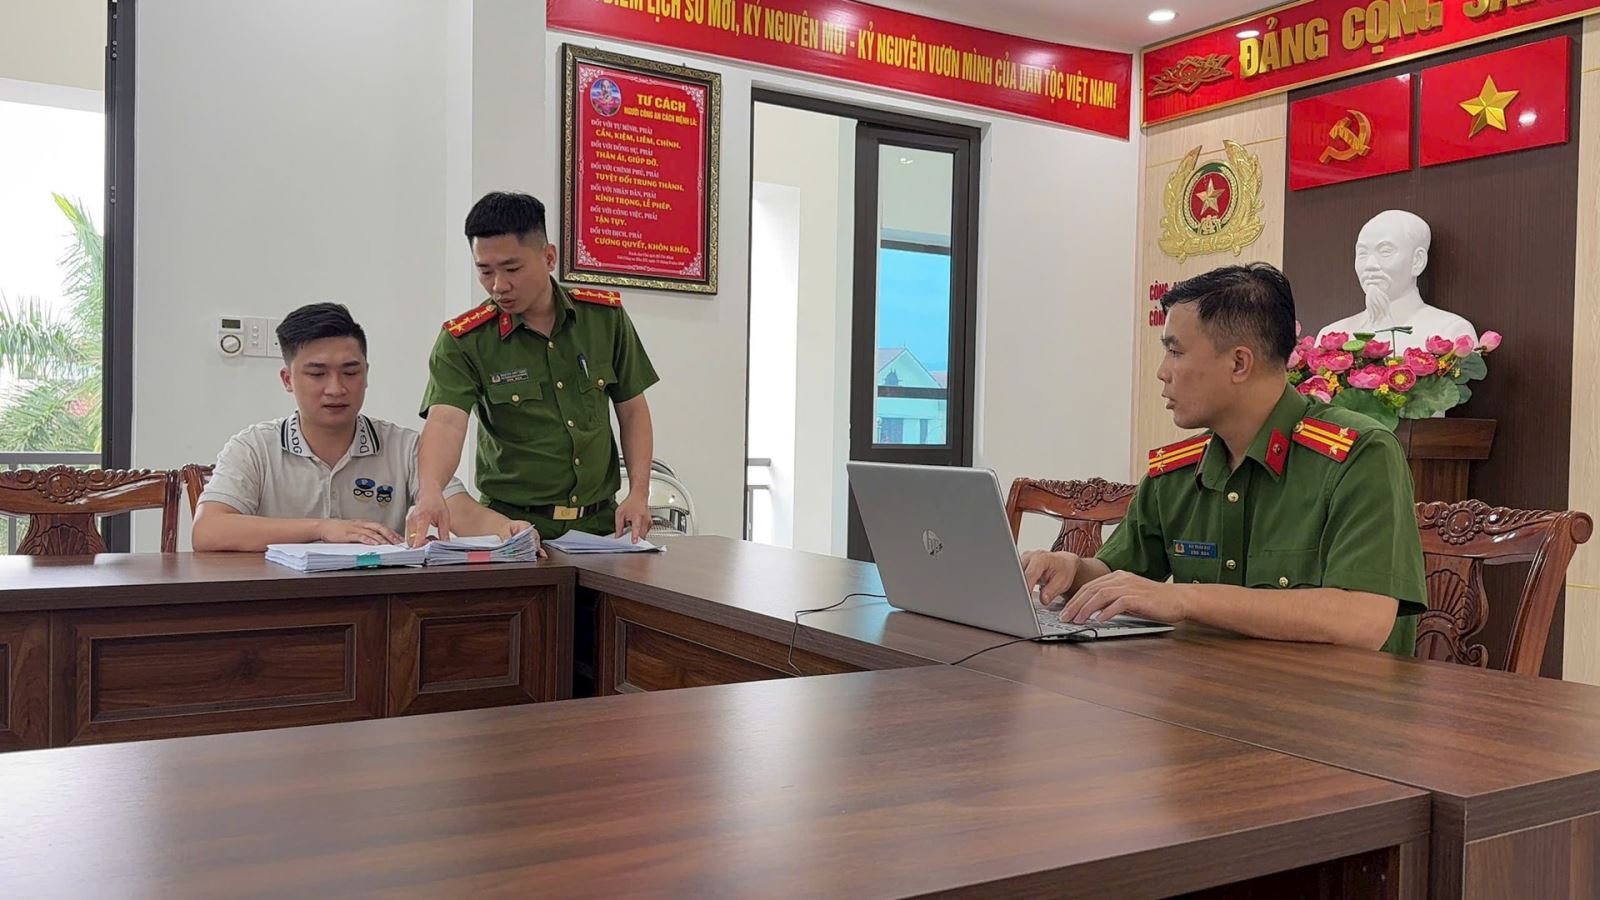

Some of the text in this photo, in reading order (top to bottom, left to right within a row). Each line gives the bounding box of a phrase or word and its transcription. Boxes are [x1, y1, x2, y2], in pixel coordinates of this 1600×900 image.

[1239, 16, 1329, 80] ĐẢNG
[764, 9, 819, 49] NGUYÊN
[858, 20, 874, 61] KỶ
[876, 33, 926, 72] NGUYÊN
[928, 44, 960, 79] VƯƠN
[962, 47, 993, 85] MÌNH
[994, 51, 1017, 90] CỦA
[1044, 64, 1064, 104] TỘC
[1066, 69, 1089, 109] VIỆT
[1089, 78, 1118, 110] NAM!
[636, 94, 687, 113] TƯ CÁCH
[595, 173, 618, 183] TUYỆT
[618, 175, 632, 184] ĐỐI
[633, 178, 657, 188] TRUNG
[595, 193, 615, 203] KÍNH
